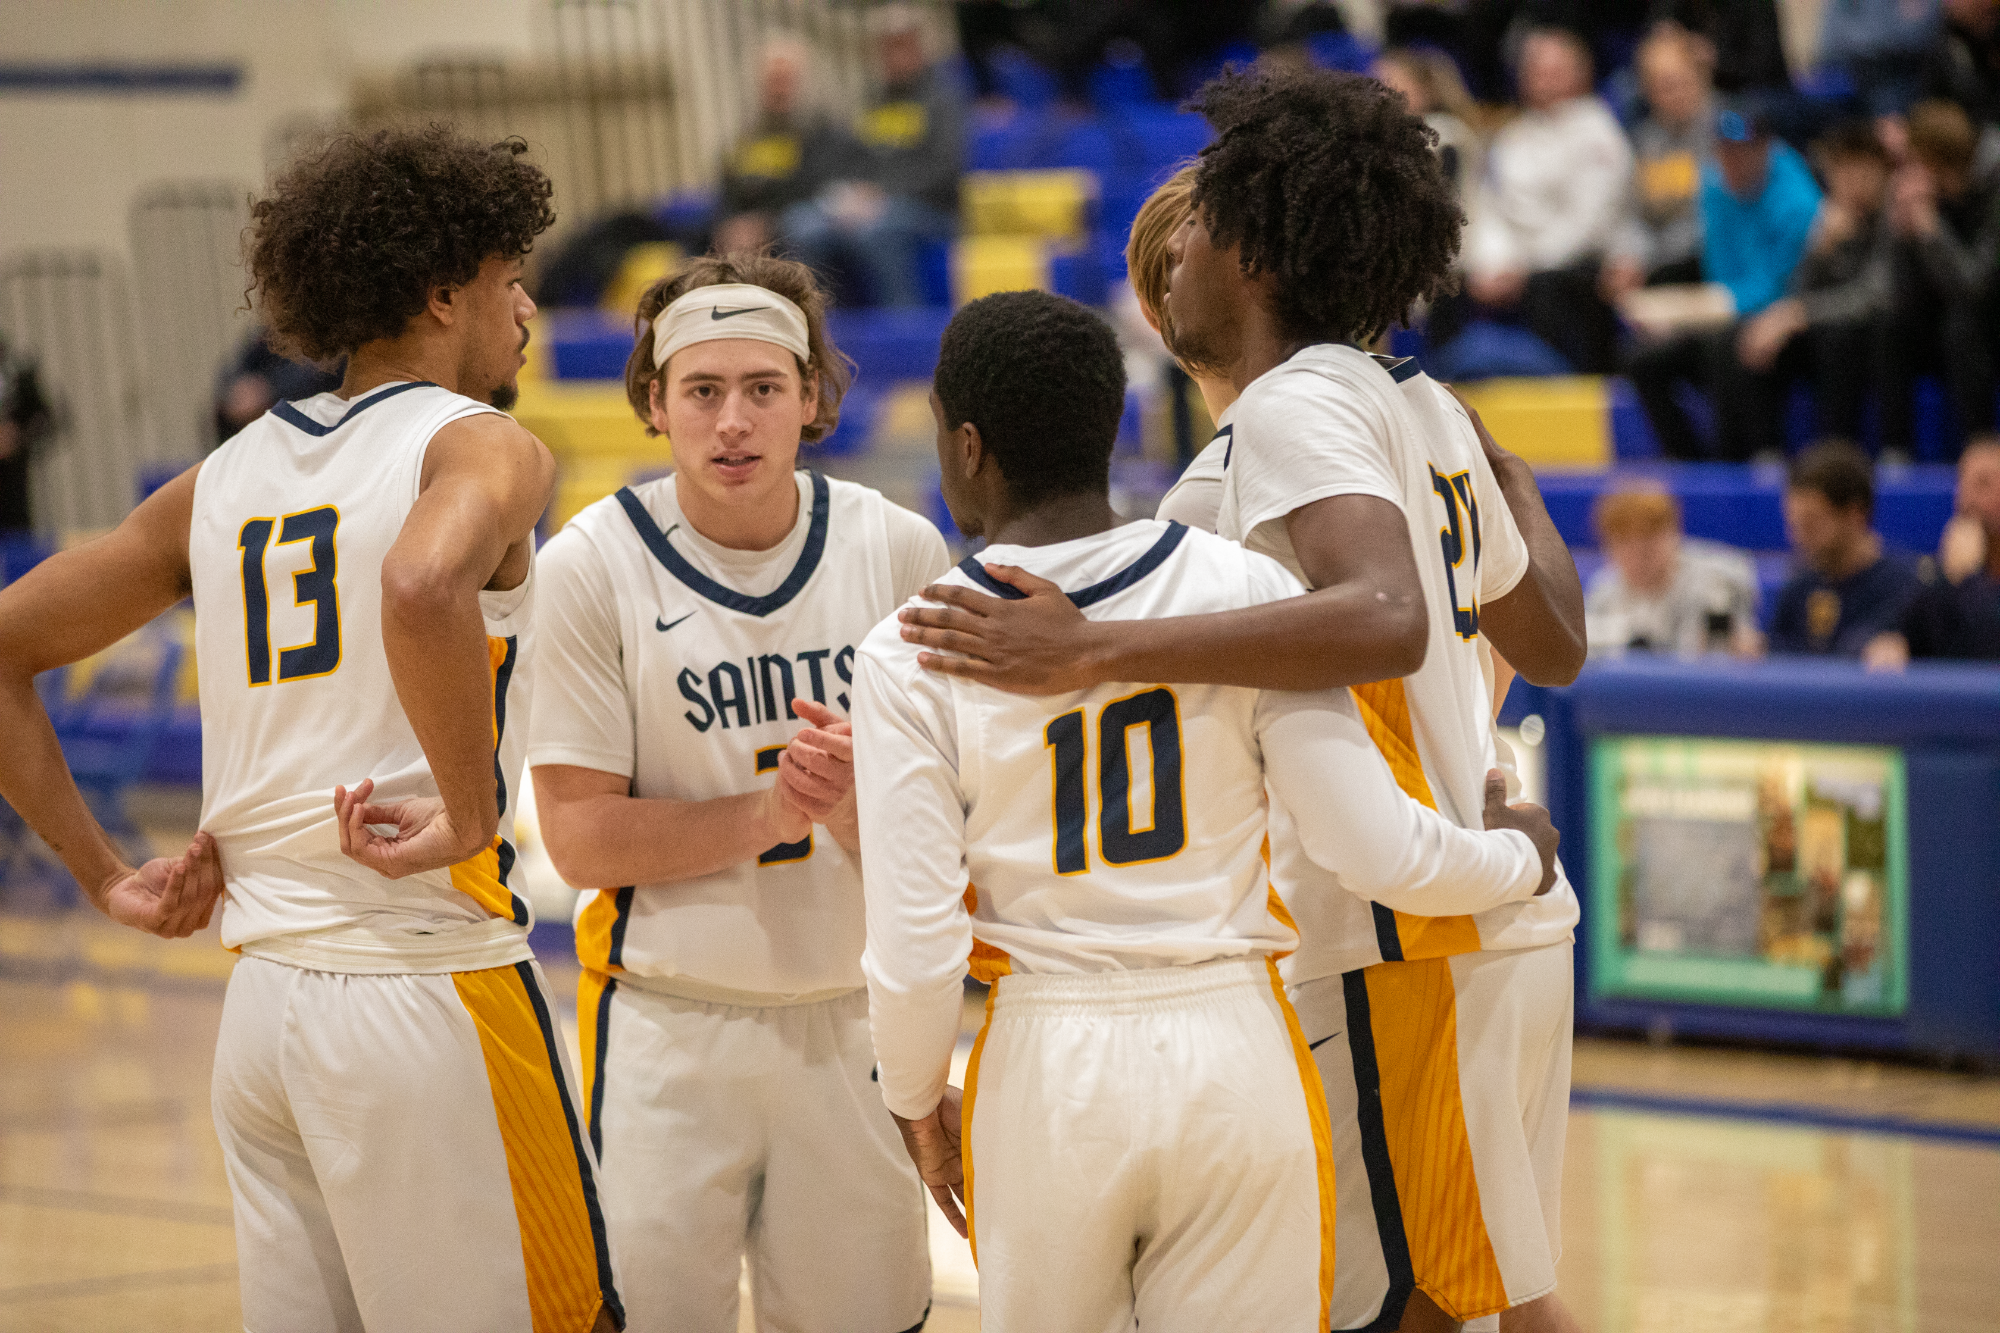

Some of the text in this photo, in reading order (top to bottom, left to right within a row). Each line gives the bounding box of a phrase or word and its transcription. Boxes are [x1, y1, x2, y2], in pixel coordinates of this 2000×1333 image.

[237, 504, 343, 688] 13
[677, 645, 855, 733] SAINTS
[1043, 684, 1189, 877] 10
